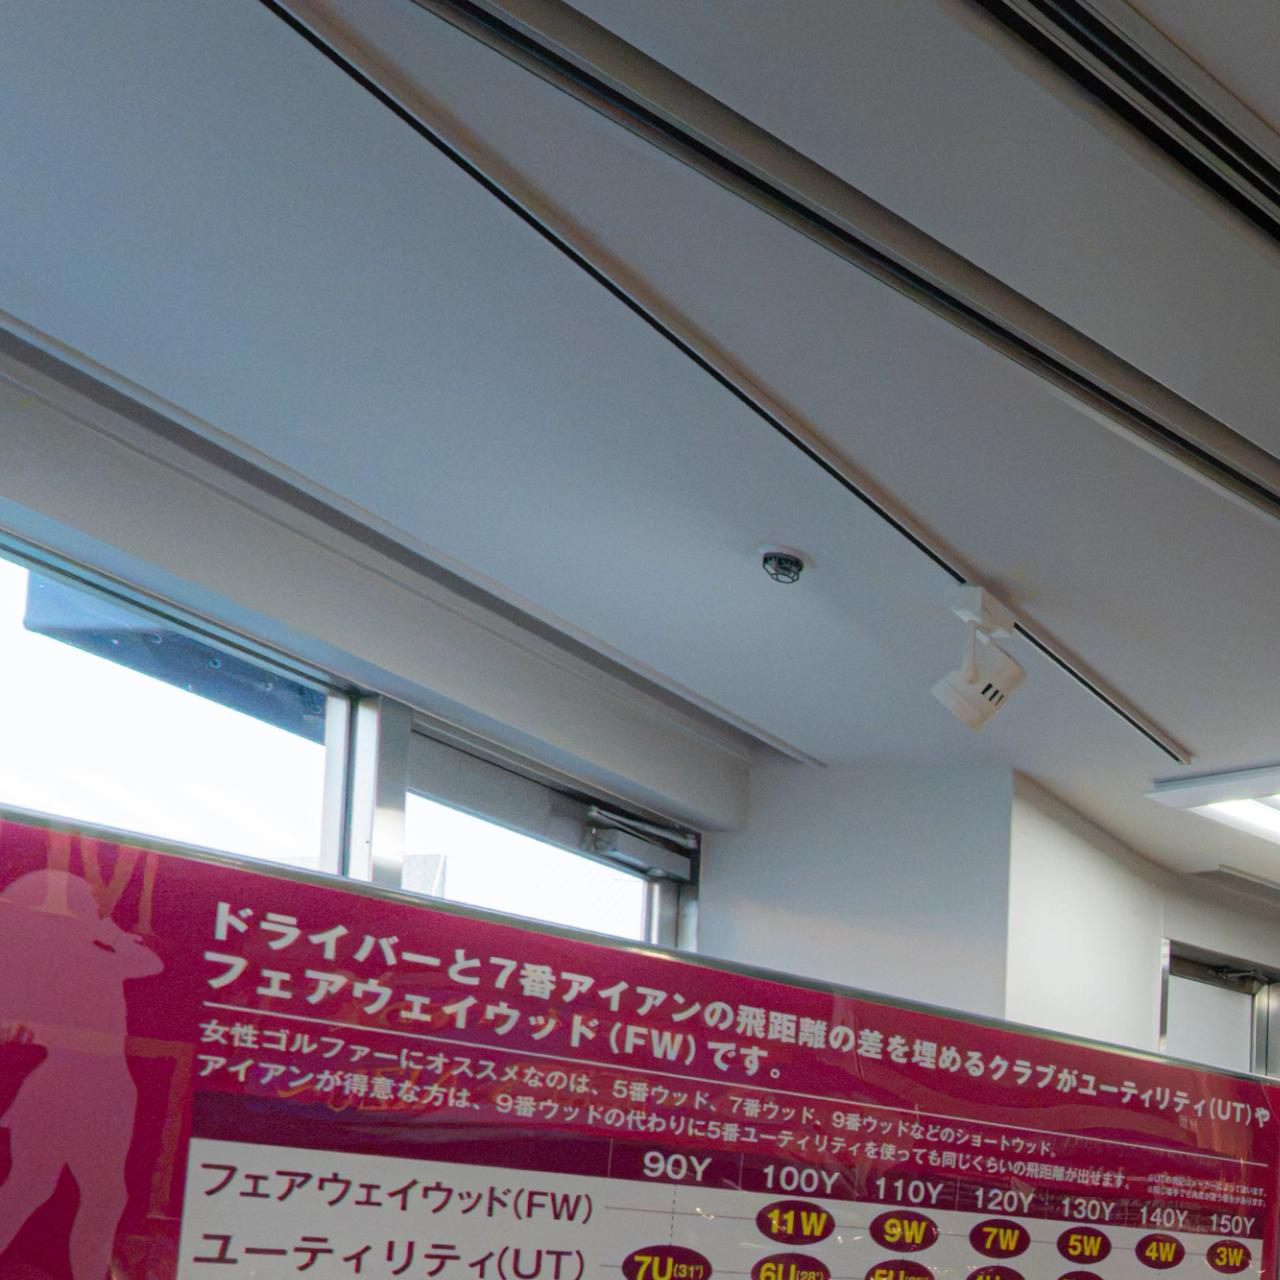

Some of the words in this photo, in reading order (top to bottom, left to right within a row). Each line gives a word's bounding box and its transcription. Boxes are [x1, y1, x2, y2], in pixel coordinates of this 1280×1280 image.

[200, 1162, 594, 1226] フェアウェイウッド(FW)
[643, 1151, 712, 1182] 90Y
[762, 1164, 841, 1195] 100Y
[875, 1177, 944, 1206] 110Y
[974, 1187, 1034, 1214] 120Y
[1061, 1198, 1115, 1222] 130Y
[1140, 1205, 1189, 1228] 140Y
[1210, 1213, 1256, 1236] 150Y
[767, 1209, 828, 1237] 11W
[883, 1217, 927, 1245] 9W
[982, 1226, 1019, 1251] 7W
[1067, 1234, 1101, 1257] 5W
[1145, 1241, 1176, 1262] 4W
[1215, 1248, 1243, 1267] 3W
